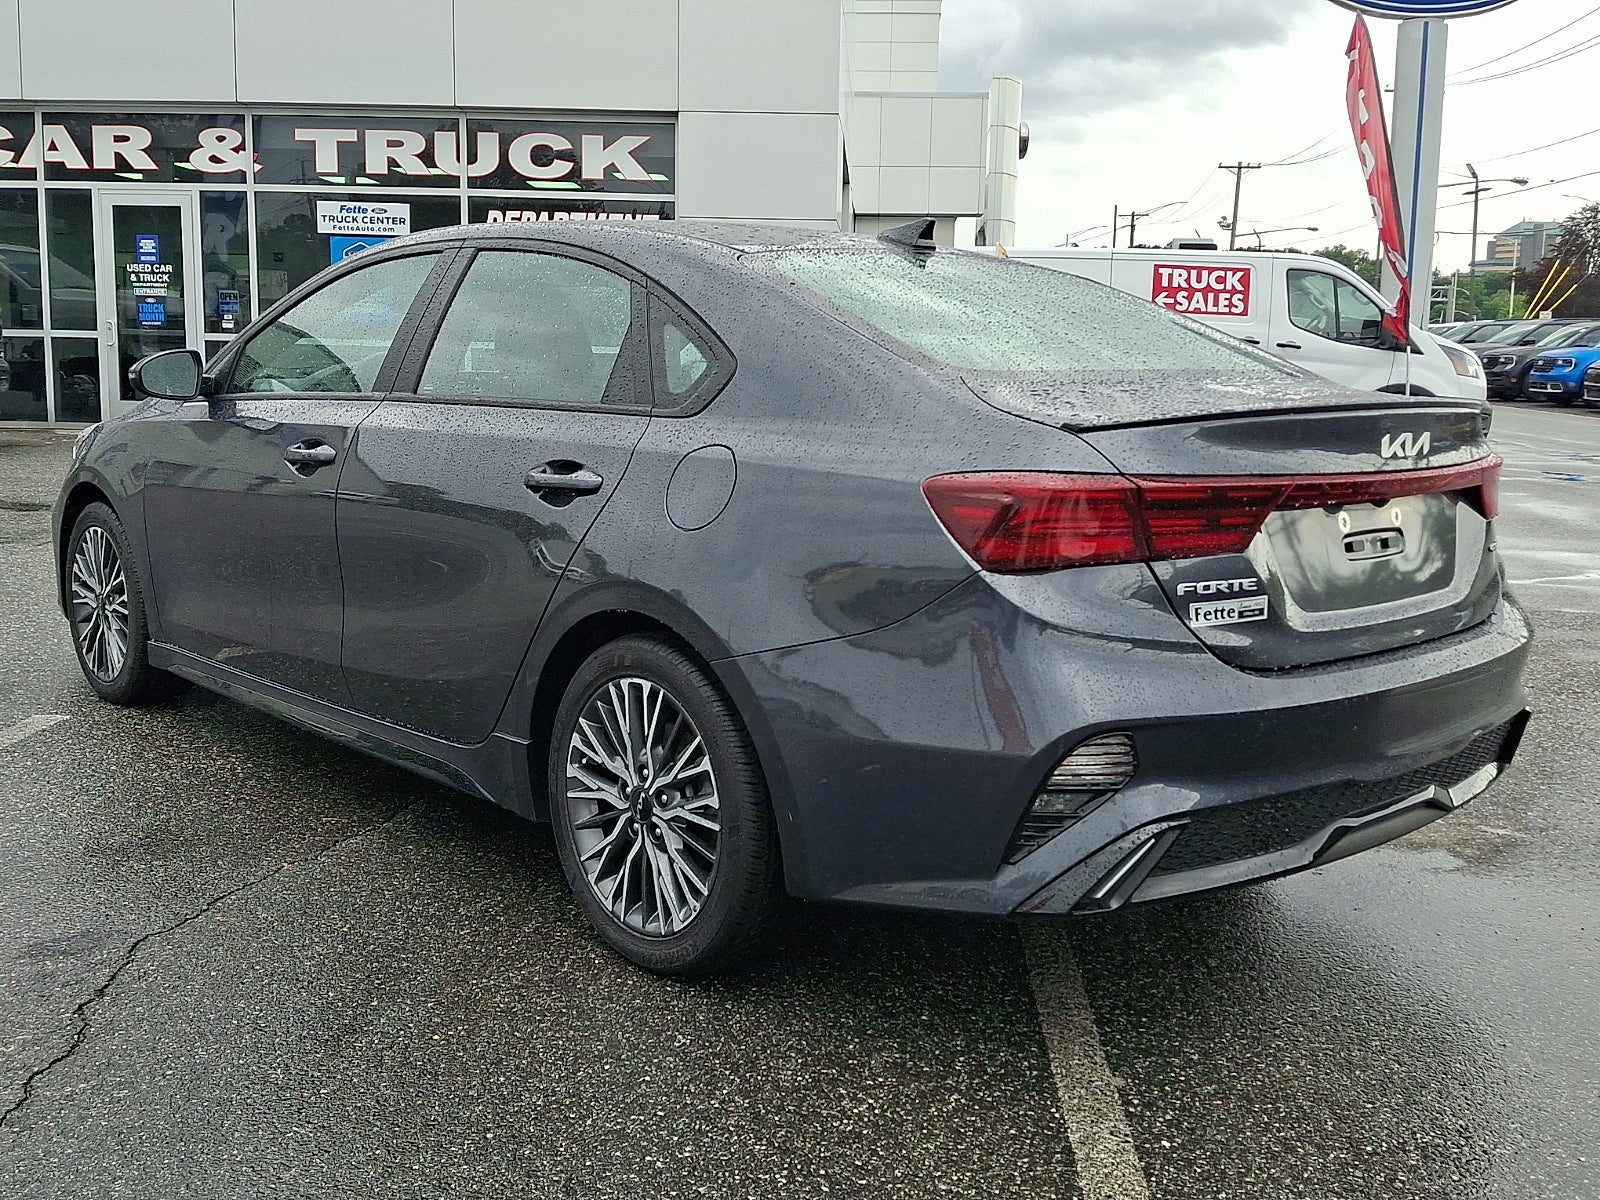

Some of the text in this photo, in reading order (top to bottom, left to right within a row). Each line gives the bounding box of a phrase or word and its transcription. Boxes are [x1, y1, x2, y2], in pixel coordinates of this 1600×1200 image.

[0, 124, 652, 181] AR & TRUCK
[339, 204, 369, 214] Fette
[320, 214, 407, 225] TRUCK CENTER
[332, 225, 395, 233] FetteAuto.com
[126, 263, 173, 273] USED CAR
[130, 273, 170, 283] & TRUCK
[1158, 267, 1245, 291] TRUCK
[219, 292, 239, 302] OPEN
[1174, 290, 1245, 314] SALES
[138, 303, 165, 313] TRUCK
[138, 312, 166, 322] MONTH
[1380, 431, 1431, 458] KIA
[1176, 577, 1259, 596] FORTE
[1194, 606, 1236, 622] Fette
